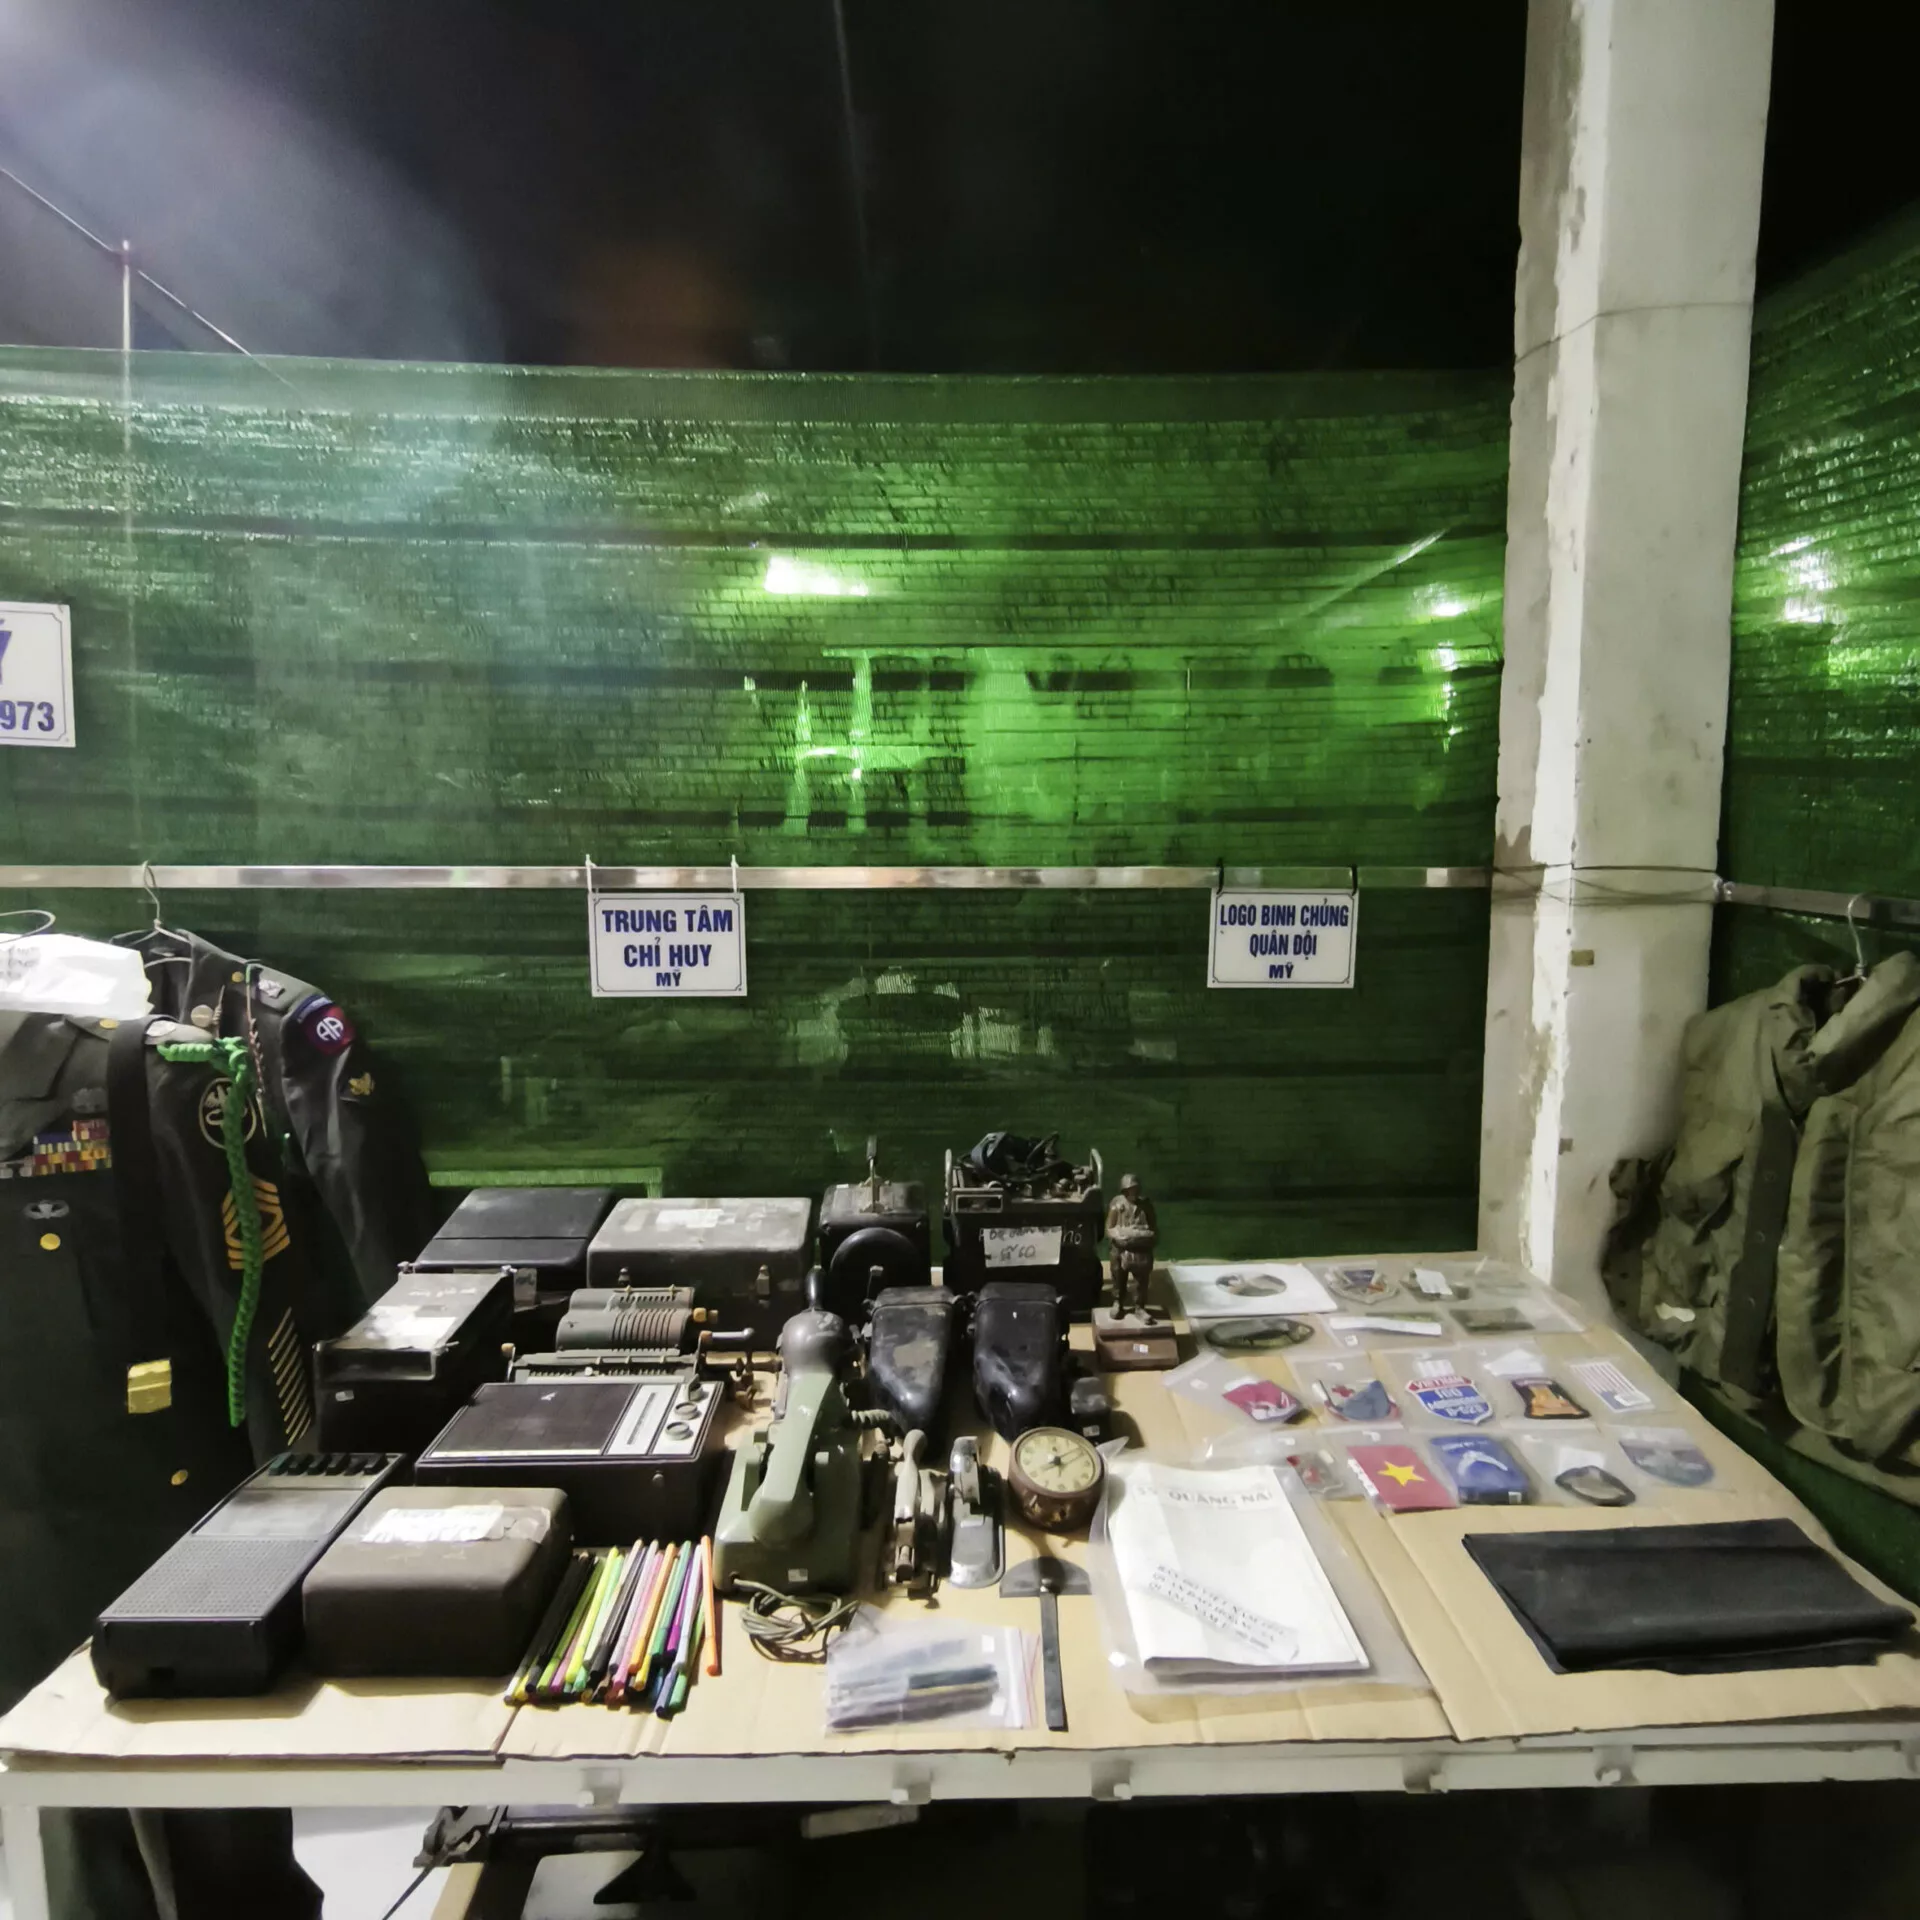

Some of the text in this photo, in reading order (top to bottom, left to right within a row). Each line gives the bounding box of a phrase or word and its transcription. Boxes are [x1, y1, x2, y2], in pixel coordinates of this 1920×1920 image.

[602, 904, 733, 933] TRUNG TÂM
[1220, 897, 1349, 927] LOGO BINH CHỦNG
[624, 936, 712, 967] CHỈ HUY
[1250, 930, 1317, 960] QUÂN ĐỘI
[656, 969, 682, 987] MỸ
[1269, 962, 1294, 979] MỸ
